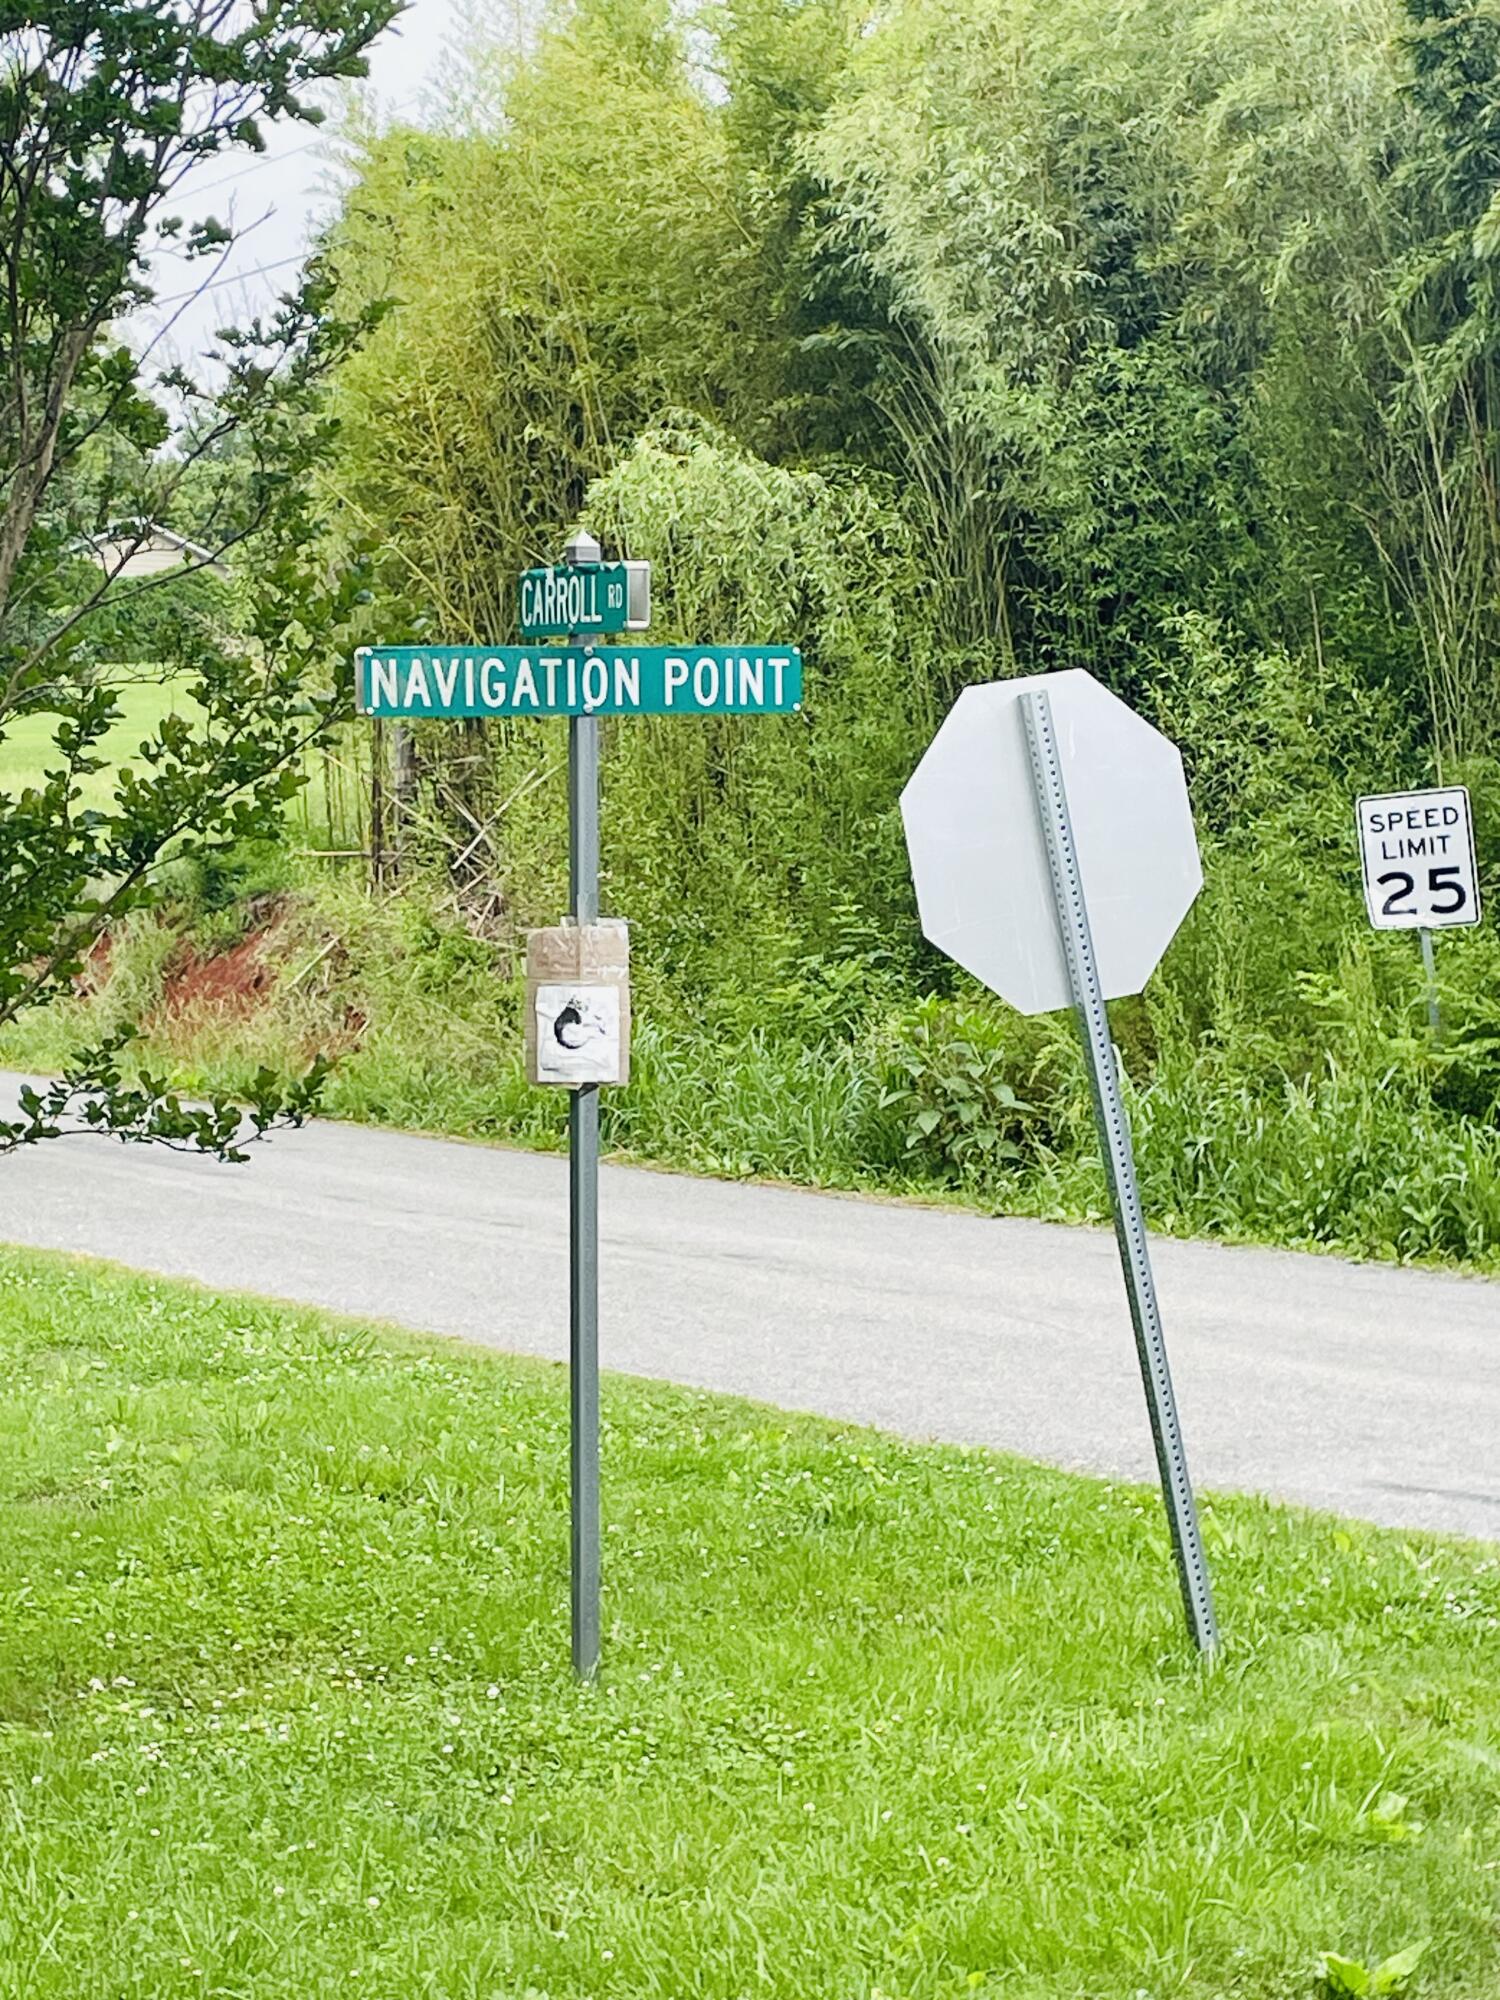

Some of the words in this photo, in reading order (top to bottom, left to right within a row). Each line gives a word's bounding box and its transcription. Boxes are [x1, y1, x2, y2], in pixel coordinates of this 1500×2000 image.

[521, 574, 602, 627] CARROLL
[607, 584, 623, 609] RD
[371, 657, 640, 708] NAVIGATION
[664, 657, 791, 707] POINT
[1369, 806, 1459, 833] SPEED
[1381, 835, 1451, 860] LIMIT
[1376, 866, 1466, 915] 25
